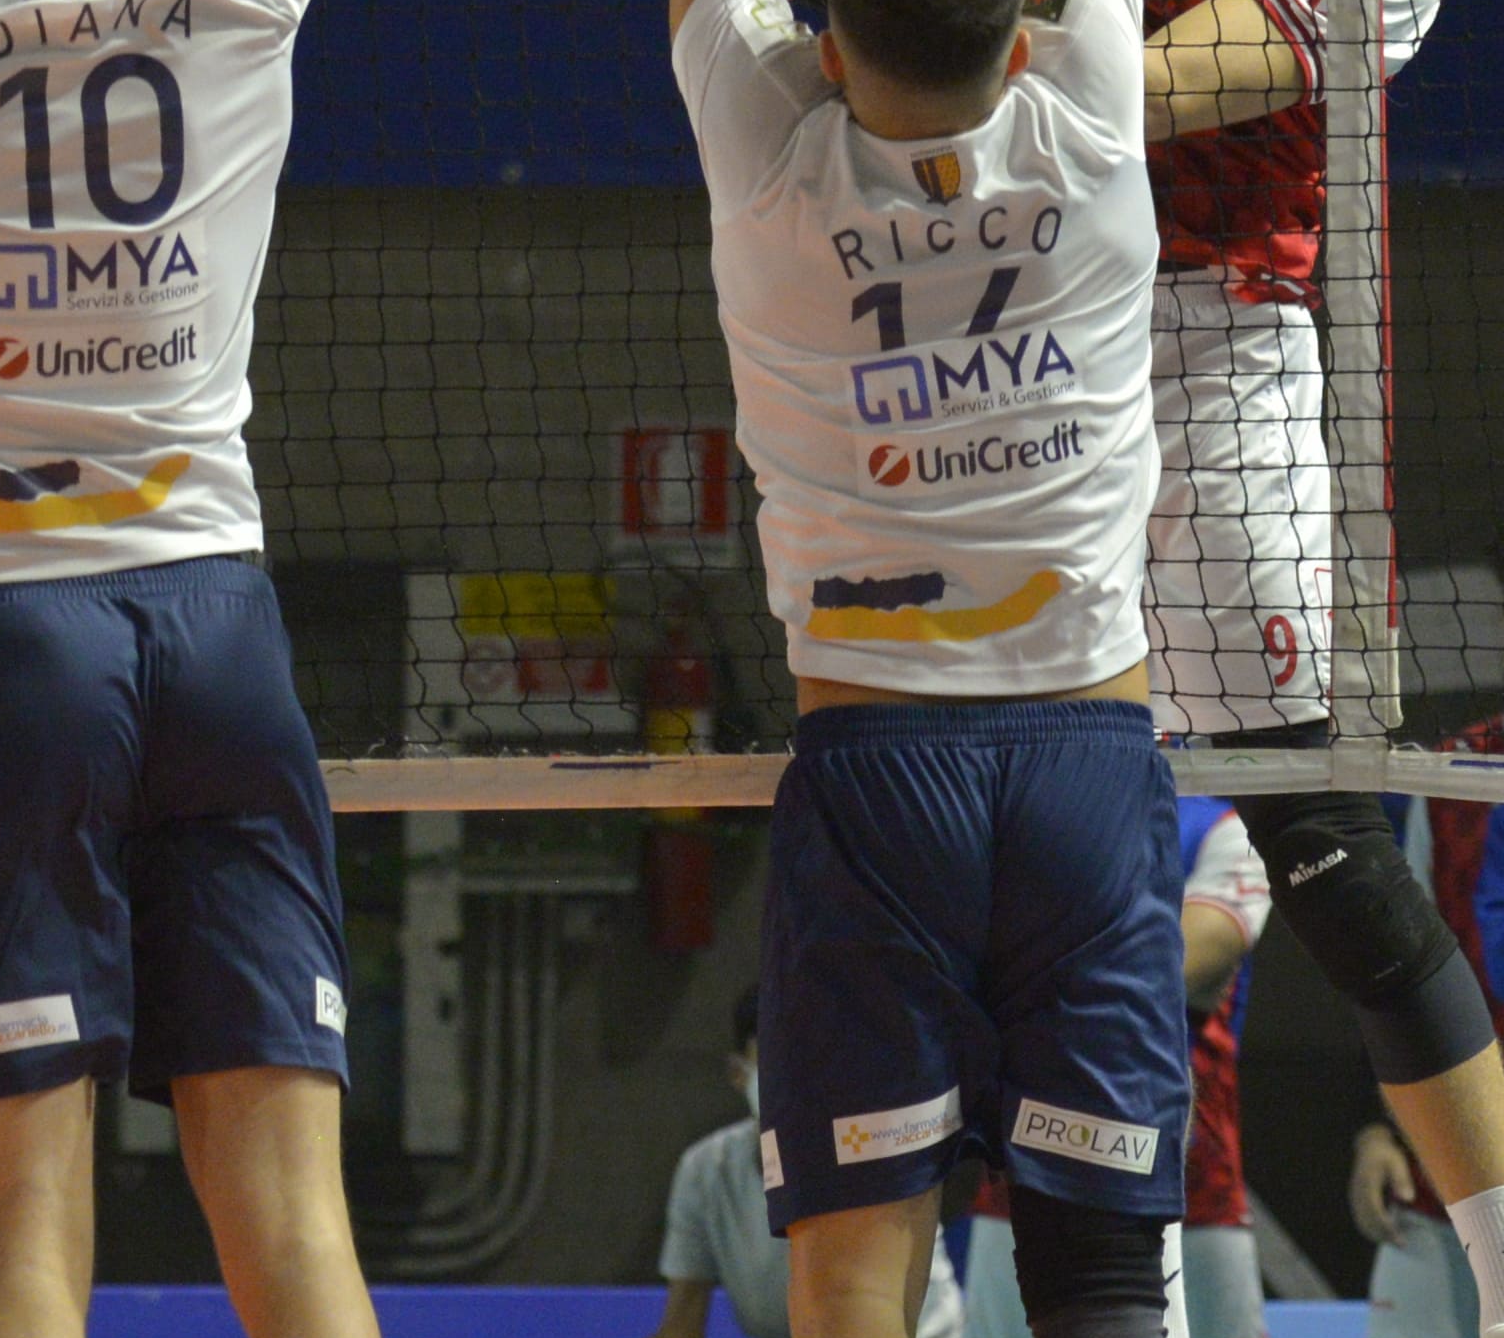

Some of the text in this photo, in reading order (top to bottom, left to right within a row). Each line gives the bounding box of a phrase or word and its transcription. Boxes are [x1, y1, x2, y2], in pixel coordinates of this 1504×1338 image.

[67, 232, 199, 289] MYA
[833, 206, 1063, 279] RICCO
[67, 280, 199, 310] Servizi & Gestione
[37, 325, 197, 377] UniCredit
[939, 330, 1075, 401] MYA
[941, 379, 1076, 418] Servizi & Gestione
[917, 419, 1084, 485] UniCredit
[1264, 614, 1298, 687] 9
[1289, 848, 1348, 887] MIKASA
[1025, 1112, 1148, 1161] PROLAV
